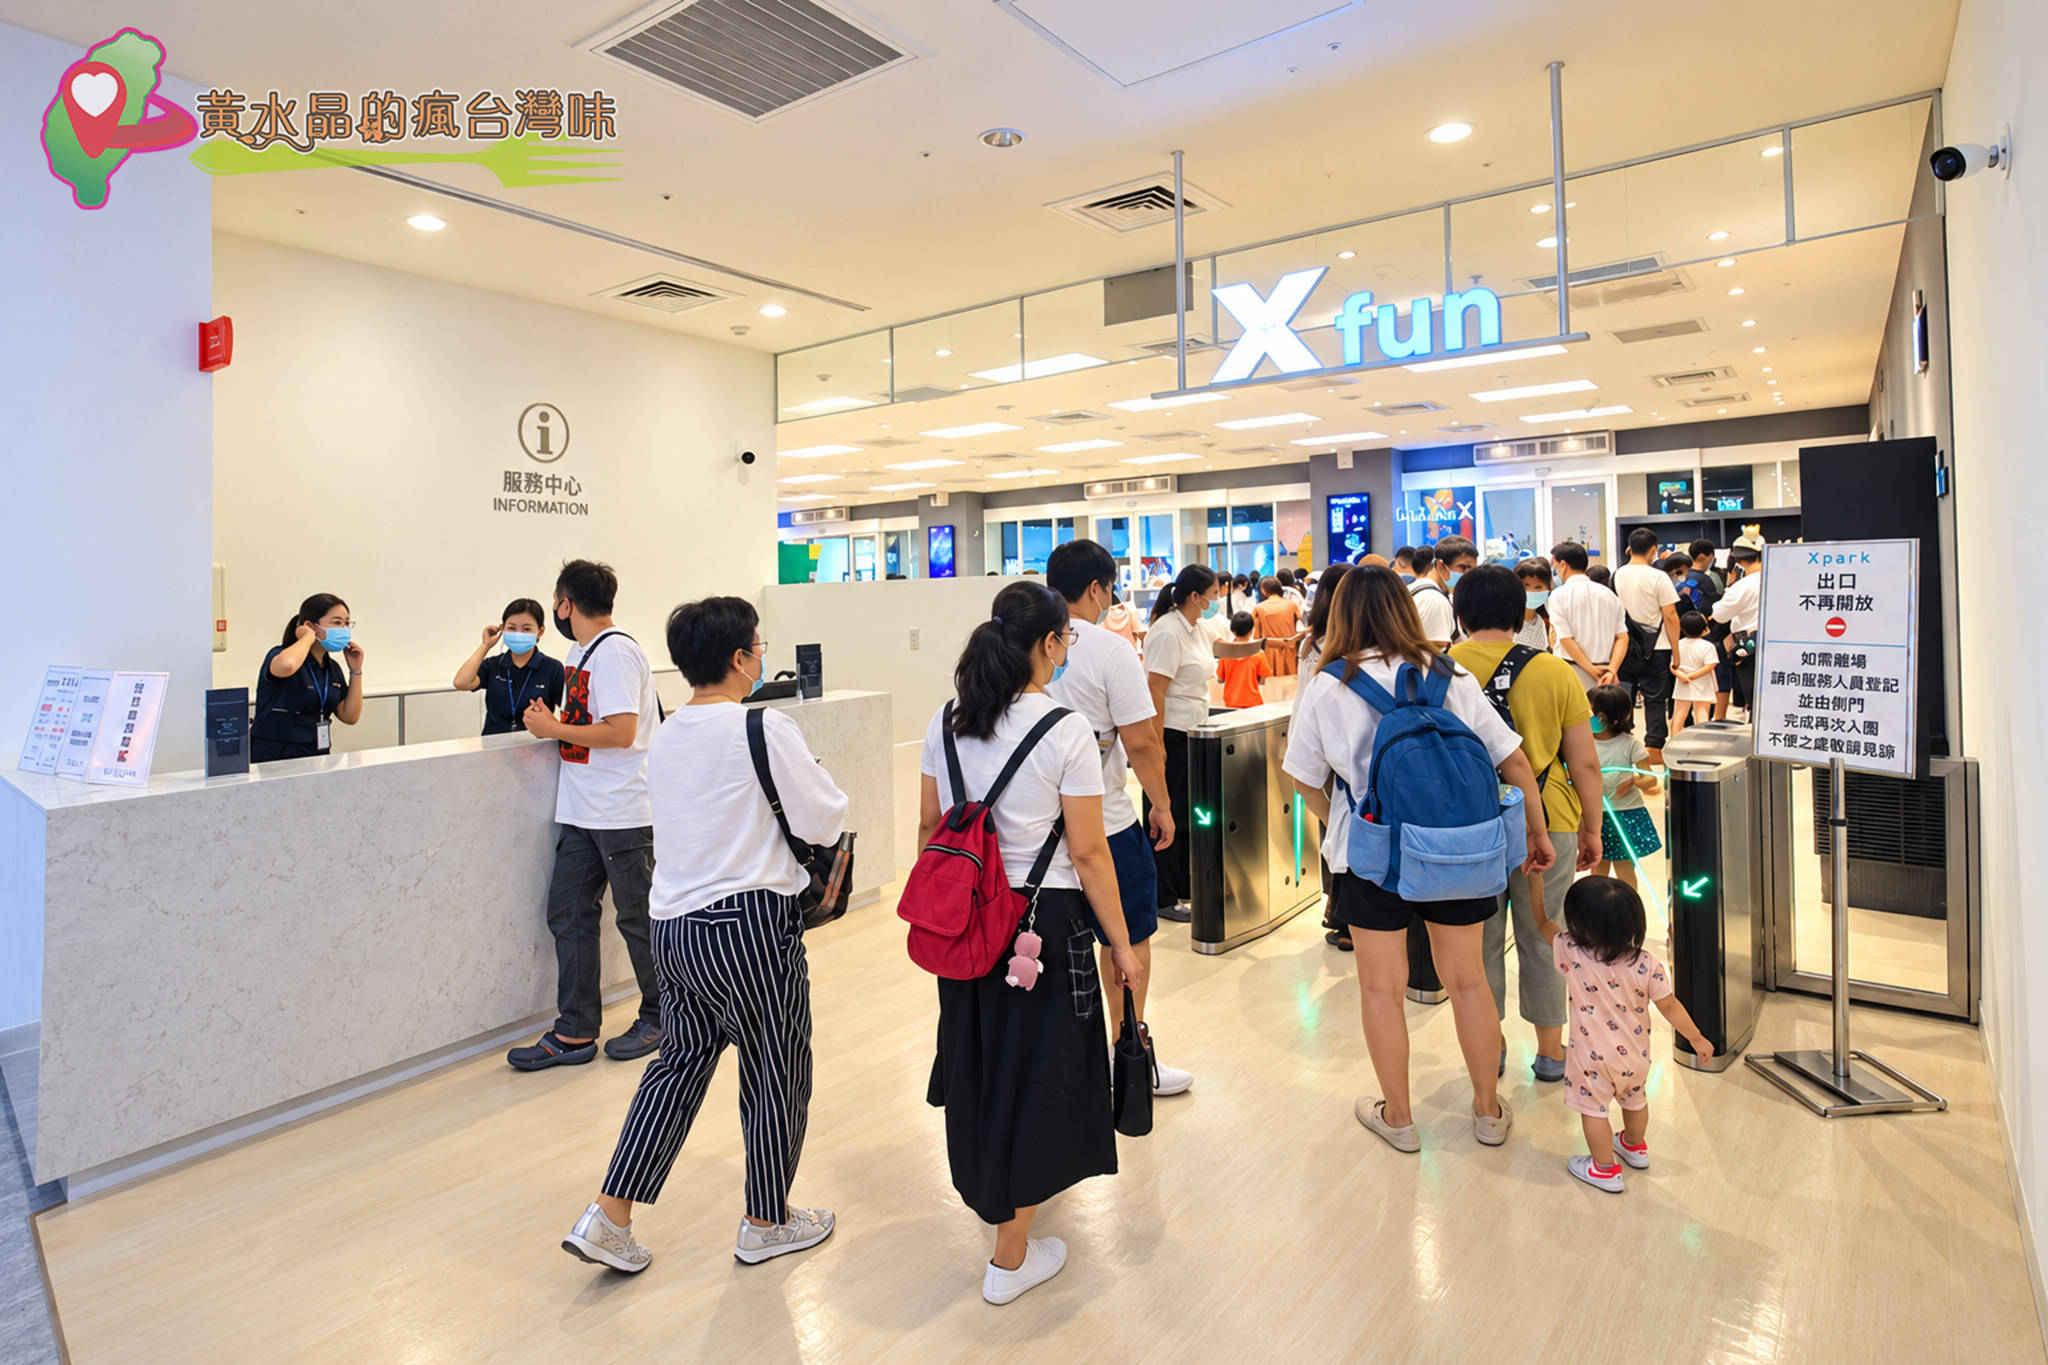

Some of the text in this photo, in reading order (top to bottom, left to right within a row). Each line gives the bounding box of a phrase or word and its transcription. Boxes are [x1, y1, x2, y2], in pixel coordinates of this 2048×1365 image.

[1210, 266, 1503, 384] X fun
[503, 470, 582, 497] 服務中心
[493, 497, 589, 515] INFORMATION
[1807, 552, 1870, 566] Xpark
[1817, 572, 1856, 590] 出口
[1799, 594, 1874, 612] 不再開放
[1801, 651, 1867, 669] 如需離場
[1770, 671, 1900, 694] 請向服務人員登記
[1798, 693, 1865, 713] 並由側門
[1784, 714, 1878, 736] 完成再次入園
[1768, 731, 1896, 760] 不便之處敬請見諒
